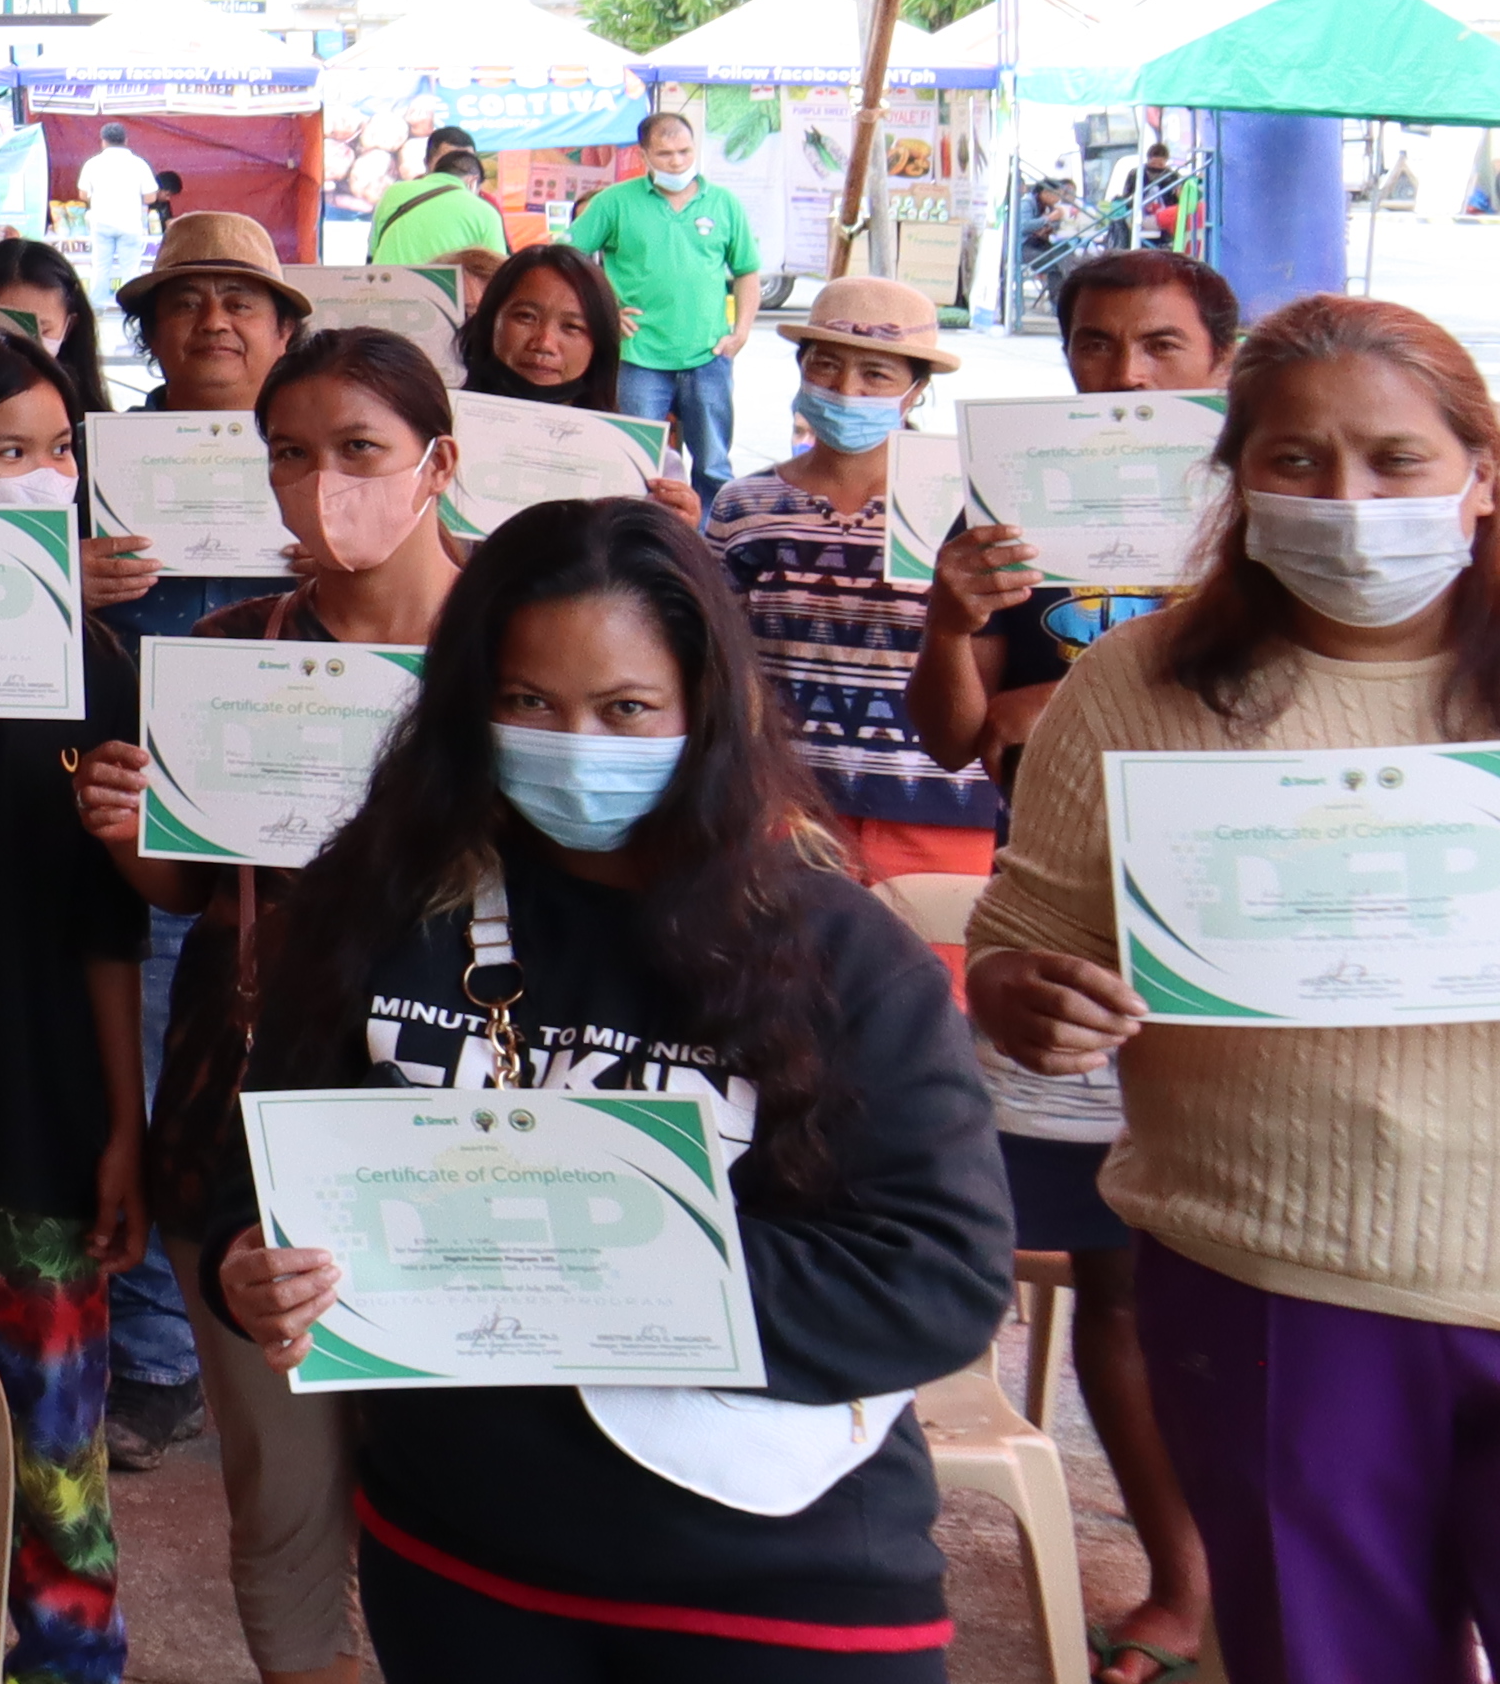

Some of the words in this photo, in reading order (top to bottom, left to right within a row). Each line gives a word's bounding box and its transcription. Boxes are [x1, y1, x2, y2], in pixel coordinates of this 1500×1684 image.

[65, 66, 124, 81] Follow
[125, 66, 273, 83] facebook/TNTph
[707, 66, 770, 81] Follow
[456, 87, 617, 117] CORTEVA
[210, 696, 281, 716] Certificate
[285, 700, 302, 716] of
[304, 700, 395, 720] Completion
[1215, 822, 1321, 842] Certificate
[1325, 822, 1350, 841] of
[1353, 819, 1475, 842] Completion
[538, 1024, 577, 1048] TO
[425, 1115, 459, 1127] Smart
[355, 1166, 459, 1185] Certificate
[465, 1166, 486, 1184] of
[490, 1167, 616, 1188] Completion
